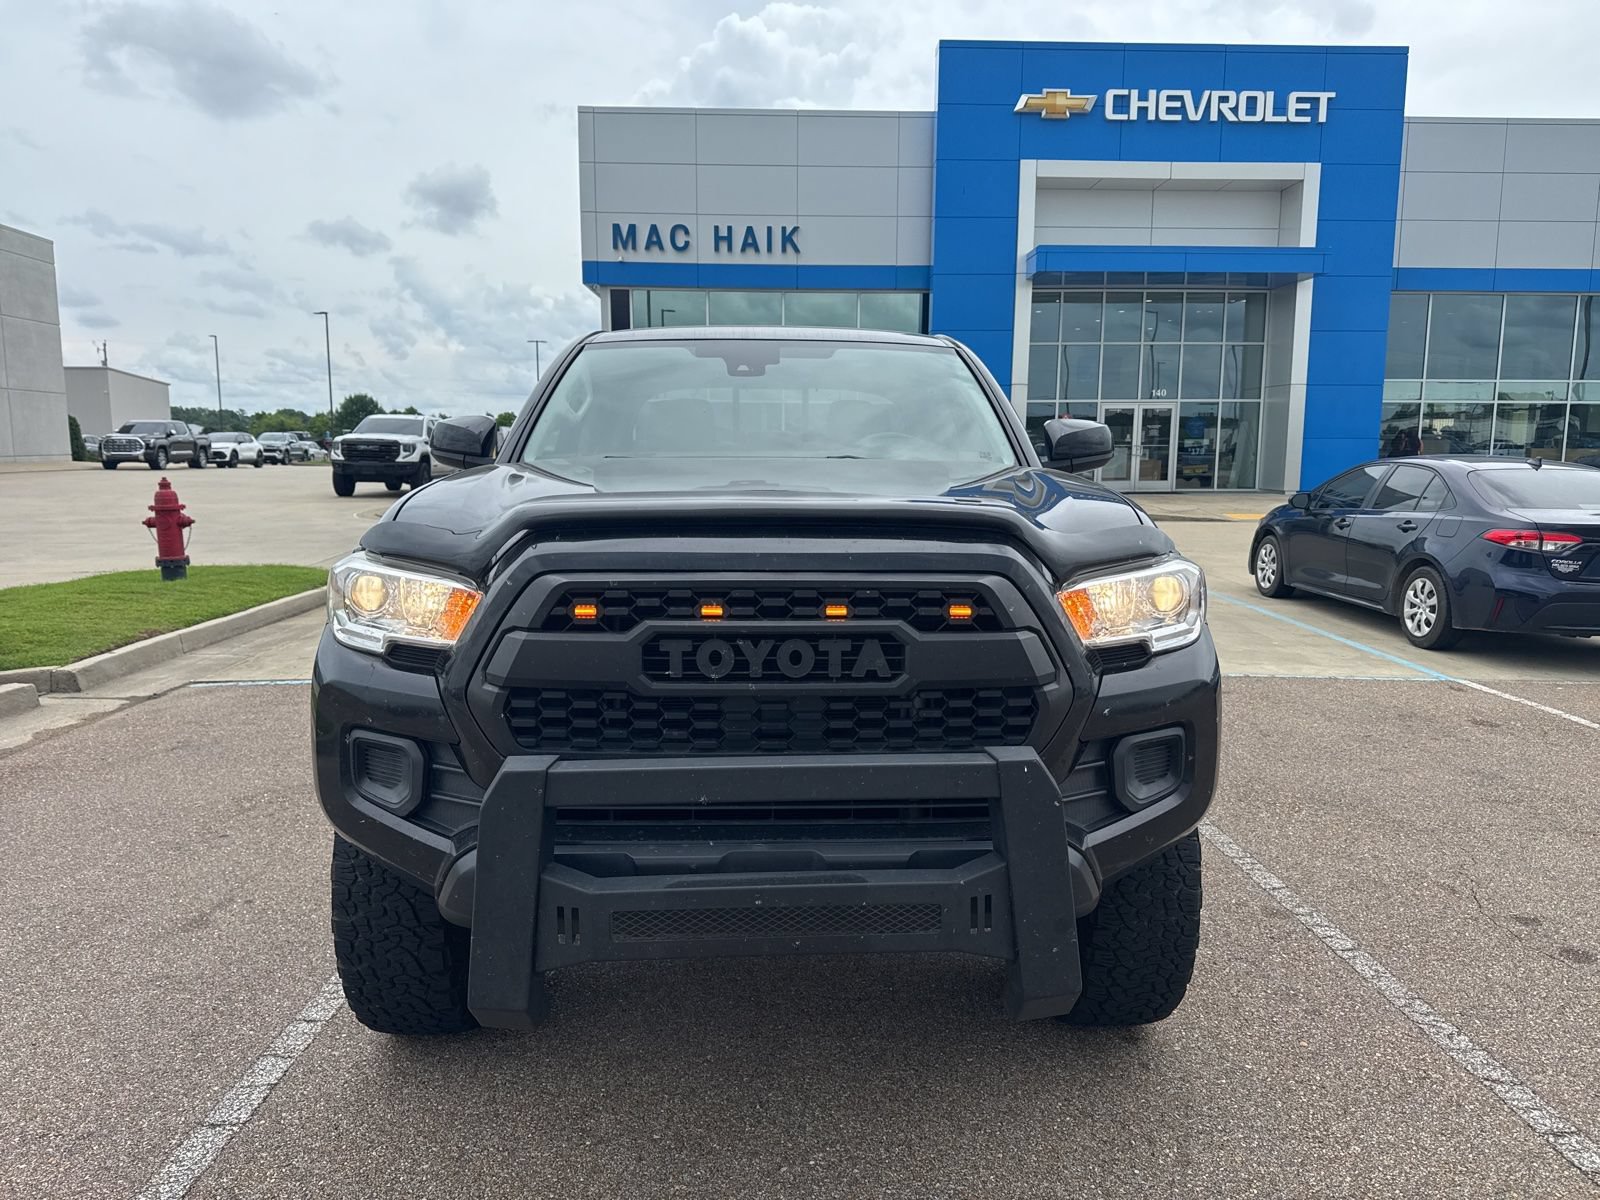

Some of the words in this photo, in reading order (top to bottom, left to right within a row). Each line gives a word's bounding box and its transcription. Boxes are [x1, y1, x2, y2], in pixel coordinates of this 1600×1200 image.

[1104, 88, 1337, 123] CHEVROLET
[612, 223, 690, 251] MAC
[714, 225, 801, 254] HAIK
[1152, 388, 1167, 397] 140
[659, 639, 892, 678] TOYOTA
